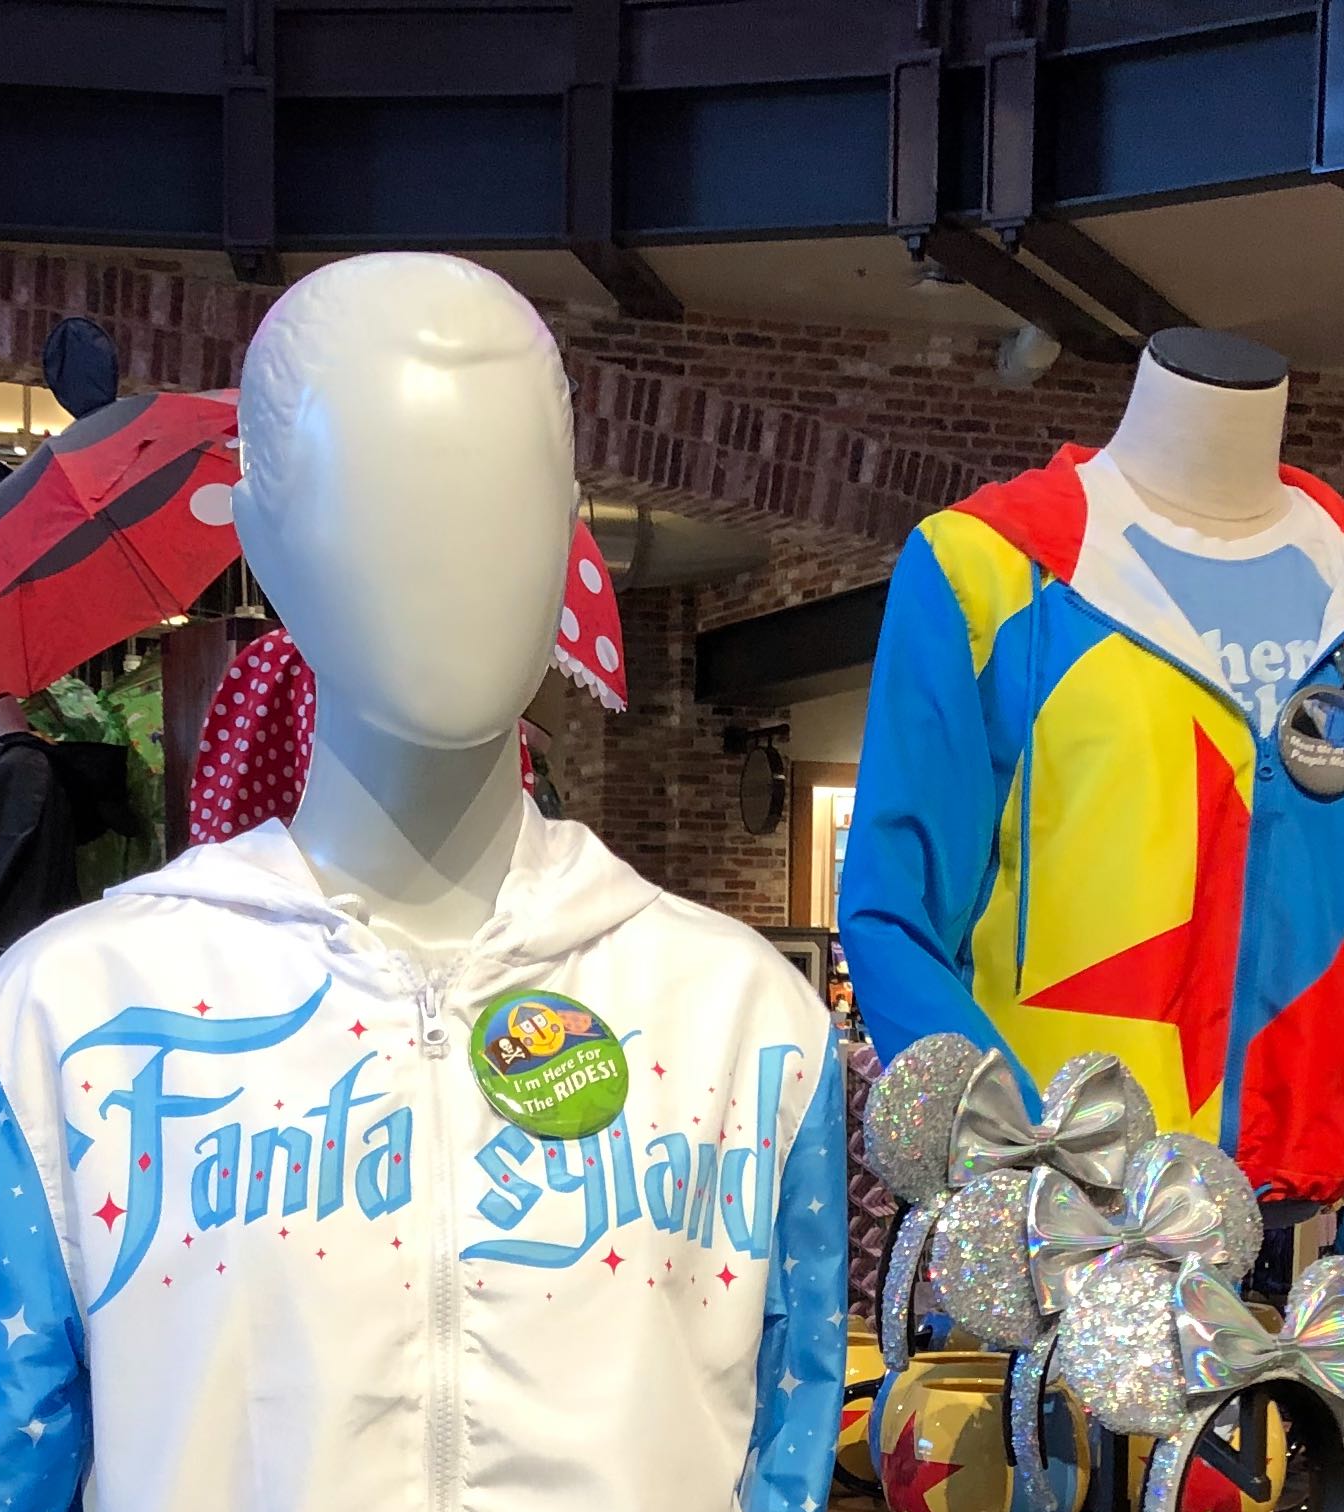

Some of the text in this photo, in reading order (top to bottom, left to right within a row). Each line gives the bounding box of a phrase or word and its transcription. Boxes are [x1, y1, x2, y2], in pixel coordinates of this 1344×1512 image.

[513, 1047, 602, 1093] I'm Here For
[523, 1059, 619, 1114] The RIDES!
